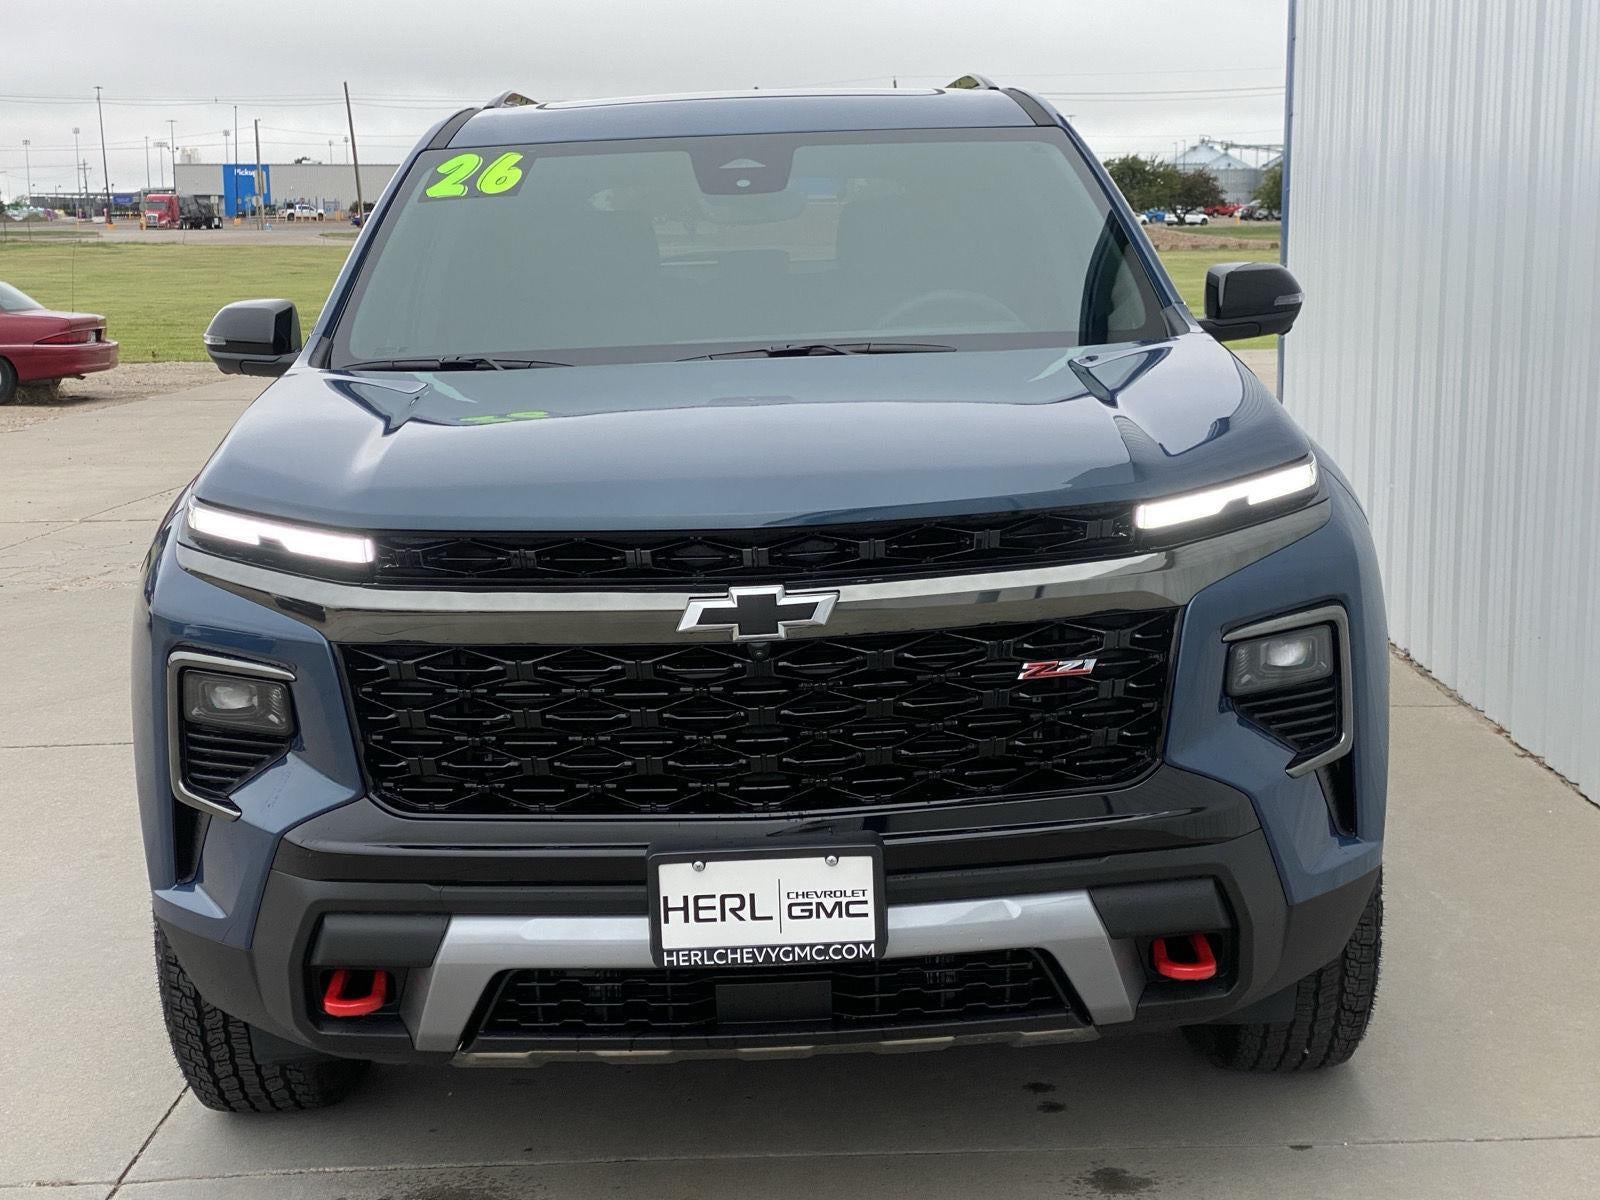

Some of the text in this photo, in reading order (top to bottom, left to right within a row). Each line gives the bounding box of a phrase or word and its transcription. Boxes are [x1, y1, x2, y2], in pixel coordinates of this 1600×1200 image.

[425, 152, 524, 198] 26
[786, 889, 868, 900] CHEVROLET
[662, 892, 773, 925] HERL
[787, 900, 869, 920] GMC
[663, 943, 875, 967] HERLCHEVYGMC.COM
